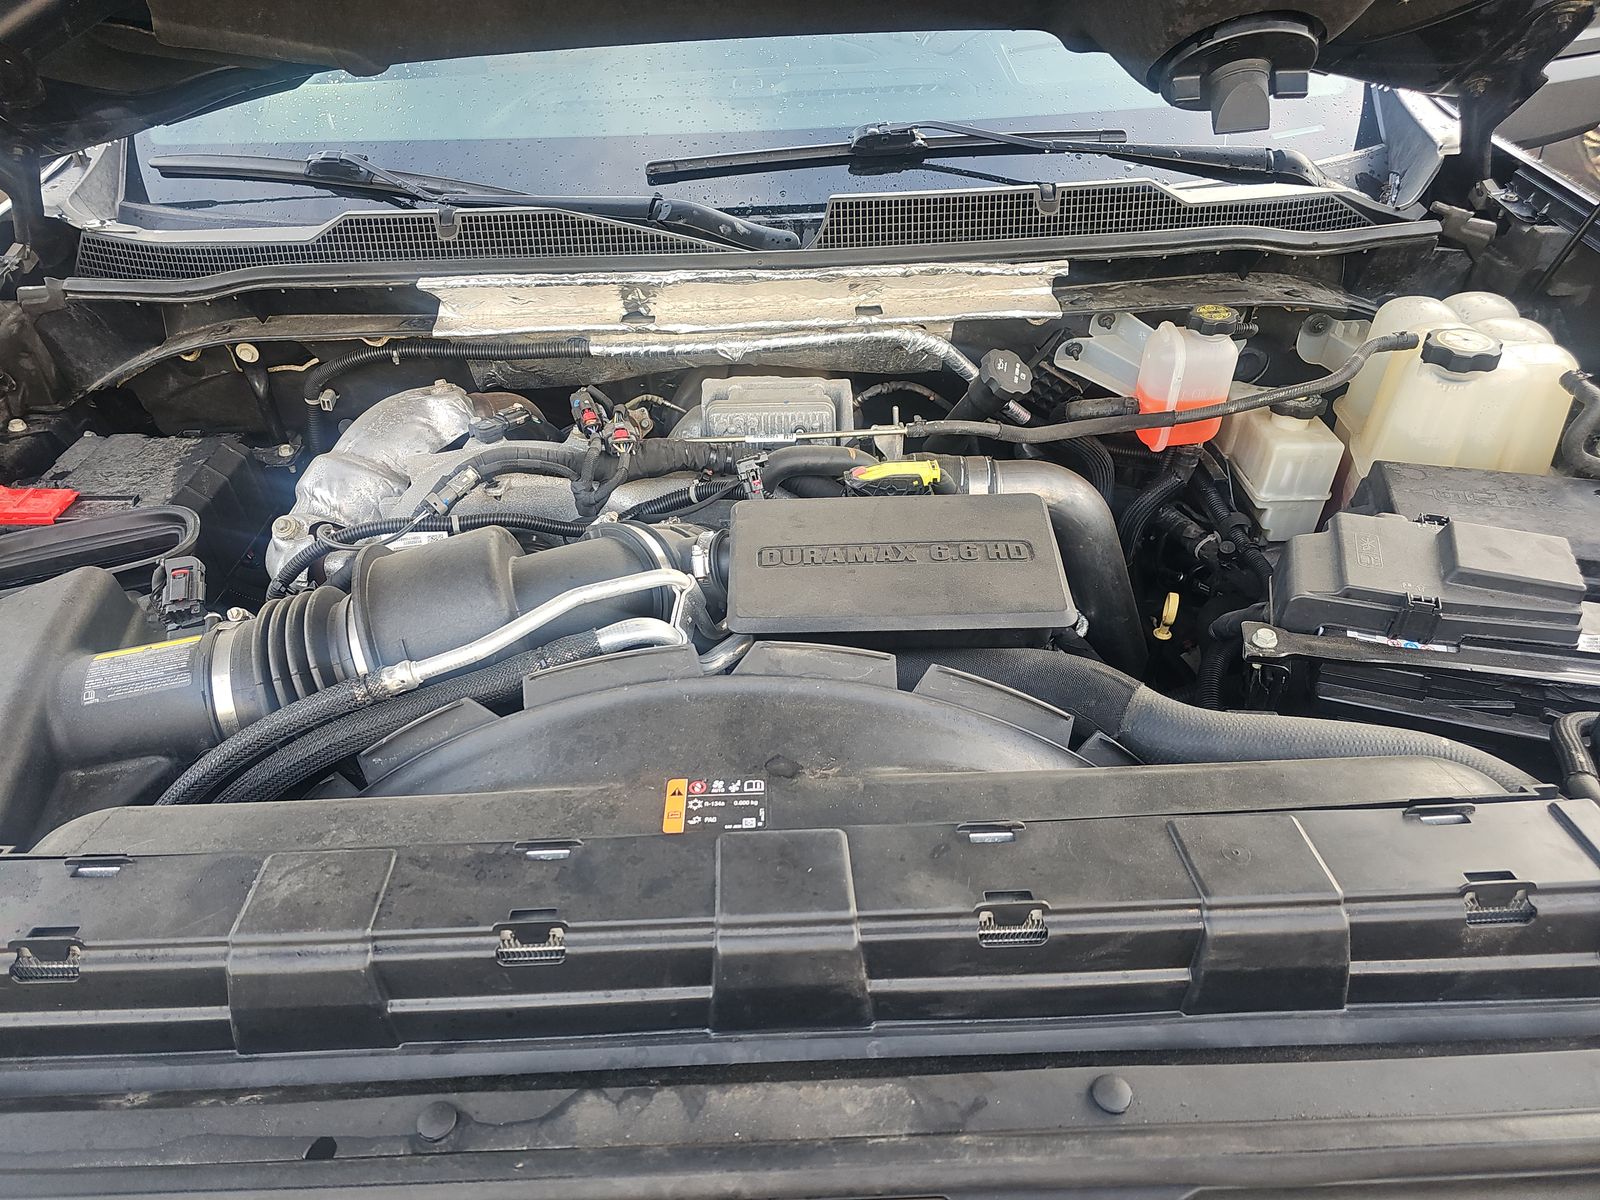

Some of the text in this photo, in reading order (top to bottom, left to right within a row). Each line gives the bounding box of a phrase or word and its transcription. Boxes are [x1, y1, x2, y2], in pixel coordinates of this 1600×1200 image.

[760, 541, 1029, 567] DURAMAX 6.6 HD
